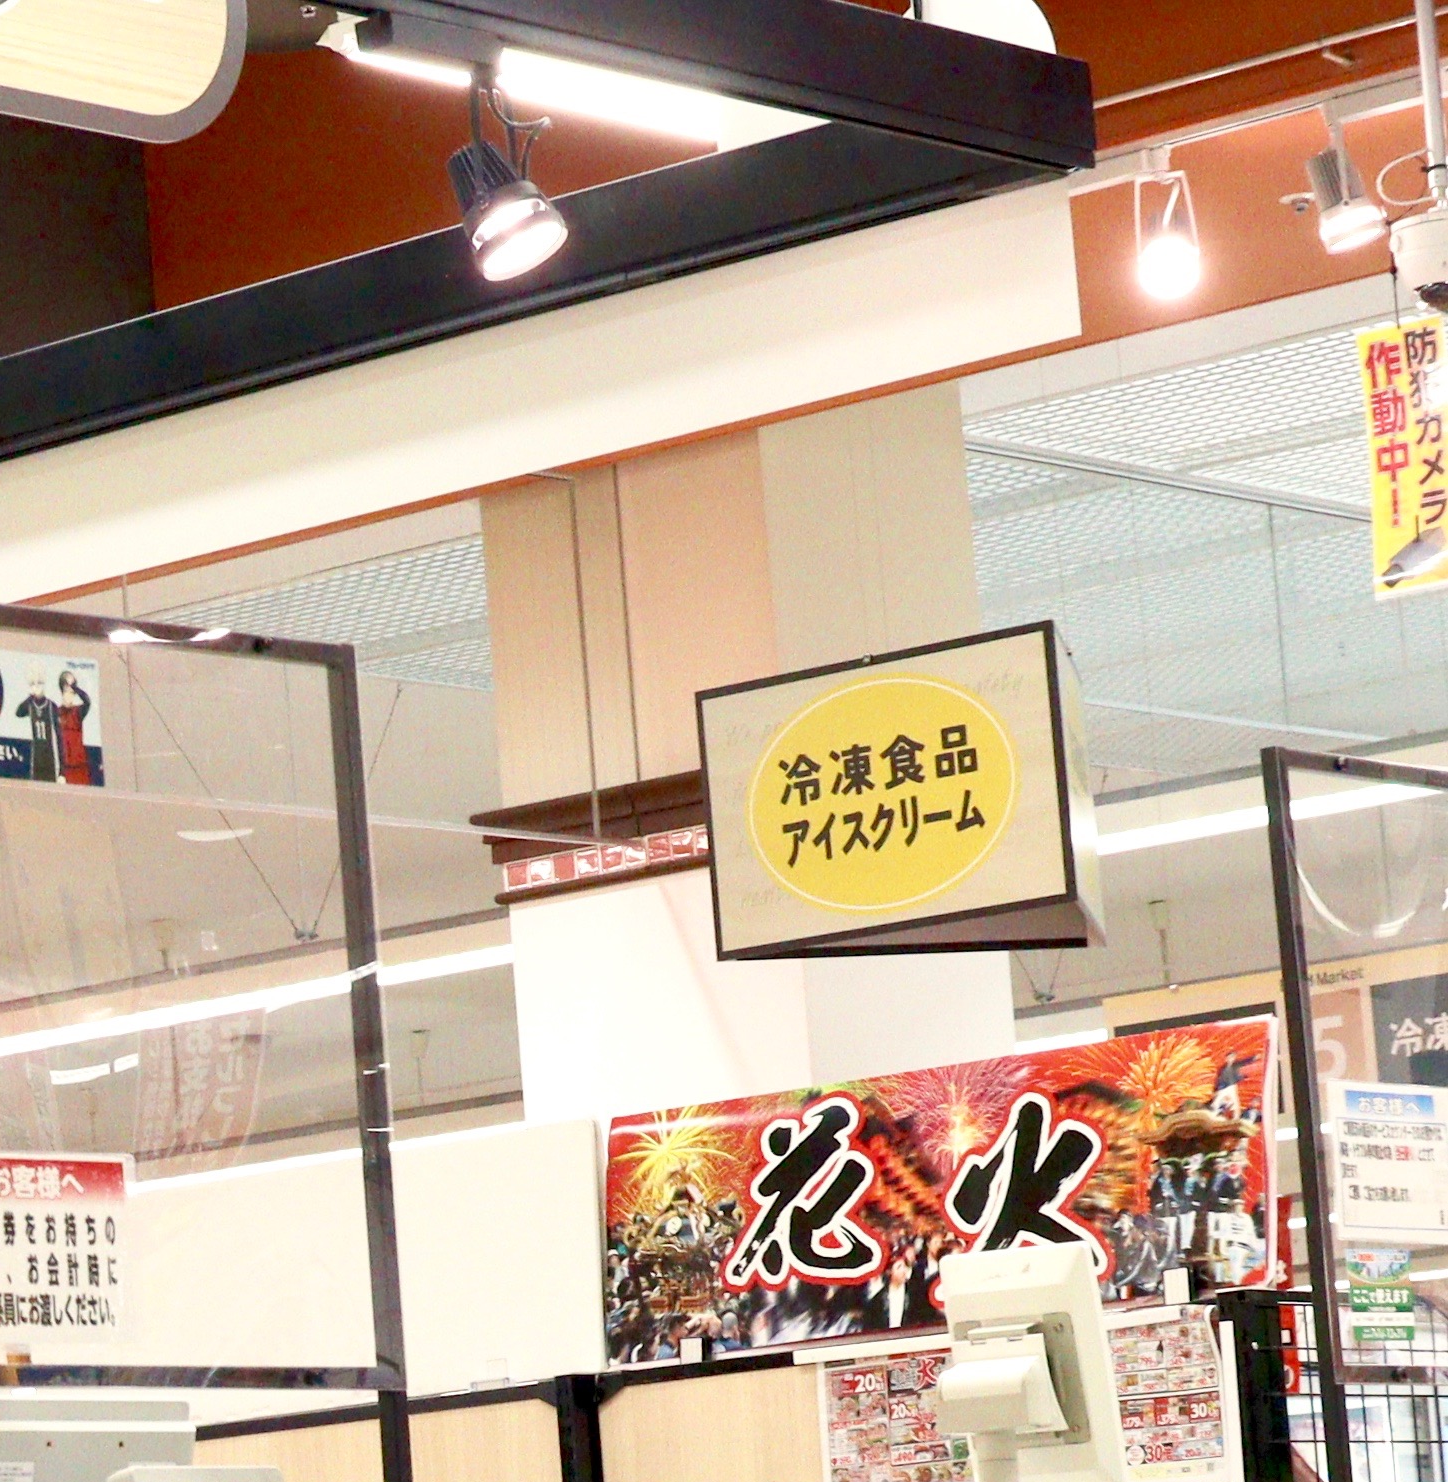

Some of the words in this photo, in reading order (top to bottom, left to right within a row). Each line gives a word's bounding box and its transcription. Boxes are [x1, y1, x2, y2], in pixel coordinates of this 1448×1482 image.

[778, 722, 979, 808] 冷凍食品
[781, 788, 987, 869] アイスクリーム
